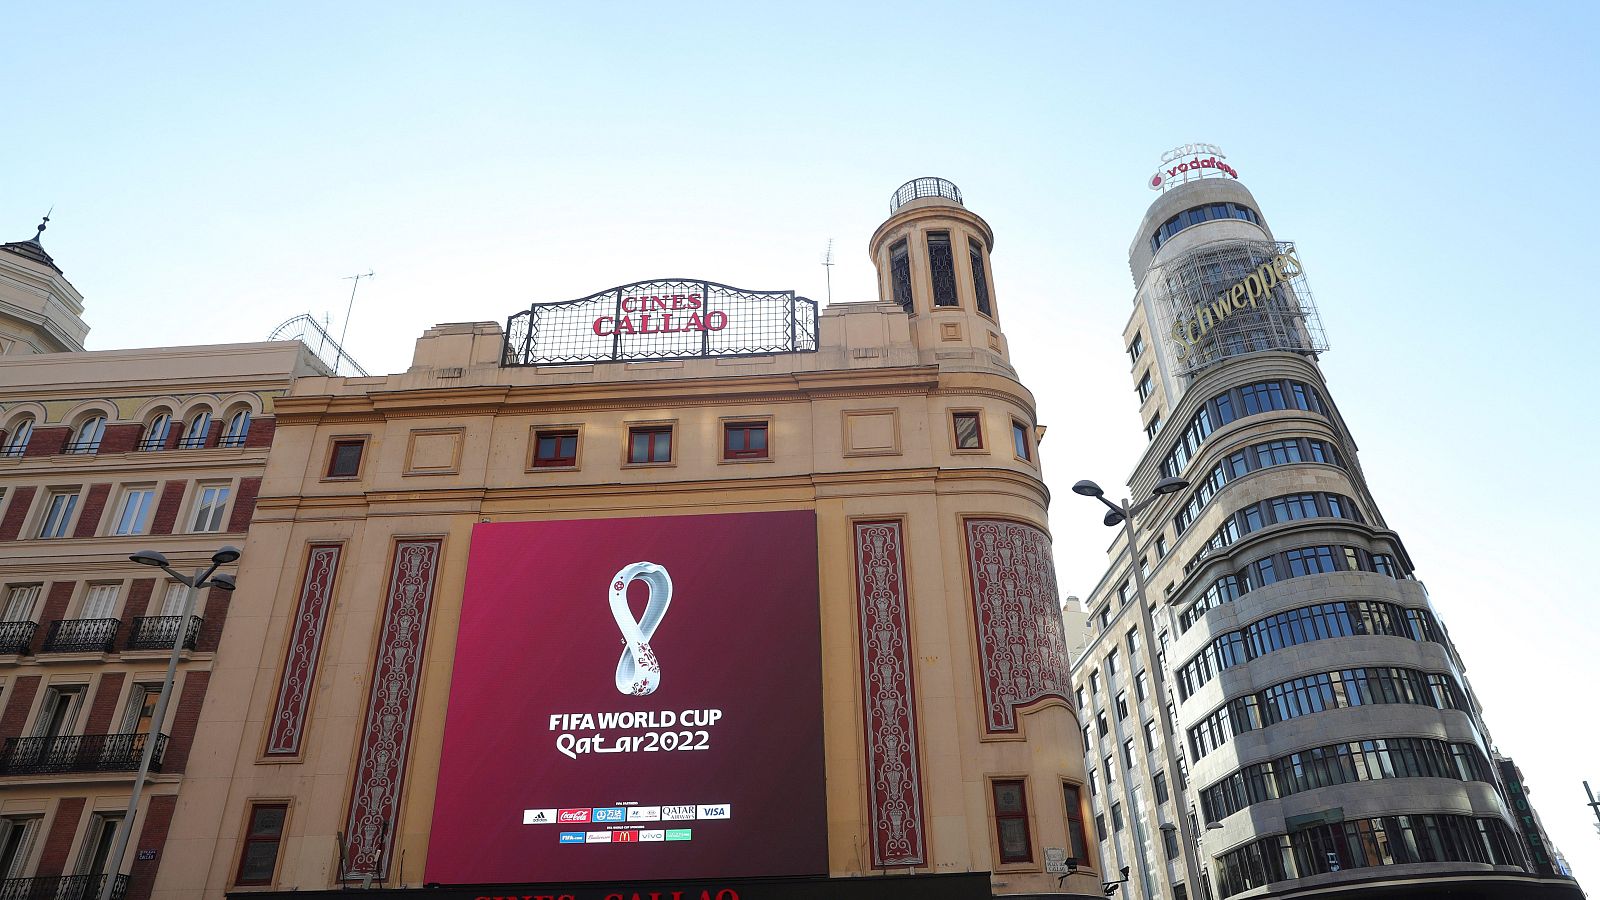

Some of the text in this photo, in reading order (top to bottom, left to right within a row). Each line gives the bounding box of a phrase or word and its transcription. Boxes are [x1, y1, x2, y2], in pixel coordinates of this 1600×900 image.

[1167, 156, 1238, 179] vodafone
[621, 293, 702, 313] CINES
[1171, 246, 1301, 363] Schweppes
[592, 310, 728, 336] CALLAO
[549, 709, 722, 731] FIFA WORLD CUP
[662, 805, 695, 816] QATAR
[704, 807, 725, 816] VISA
[1509, 781, 1547, 865] HOTEL
